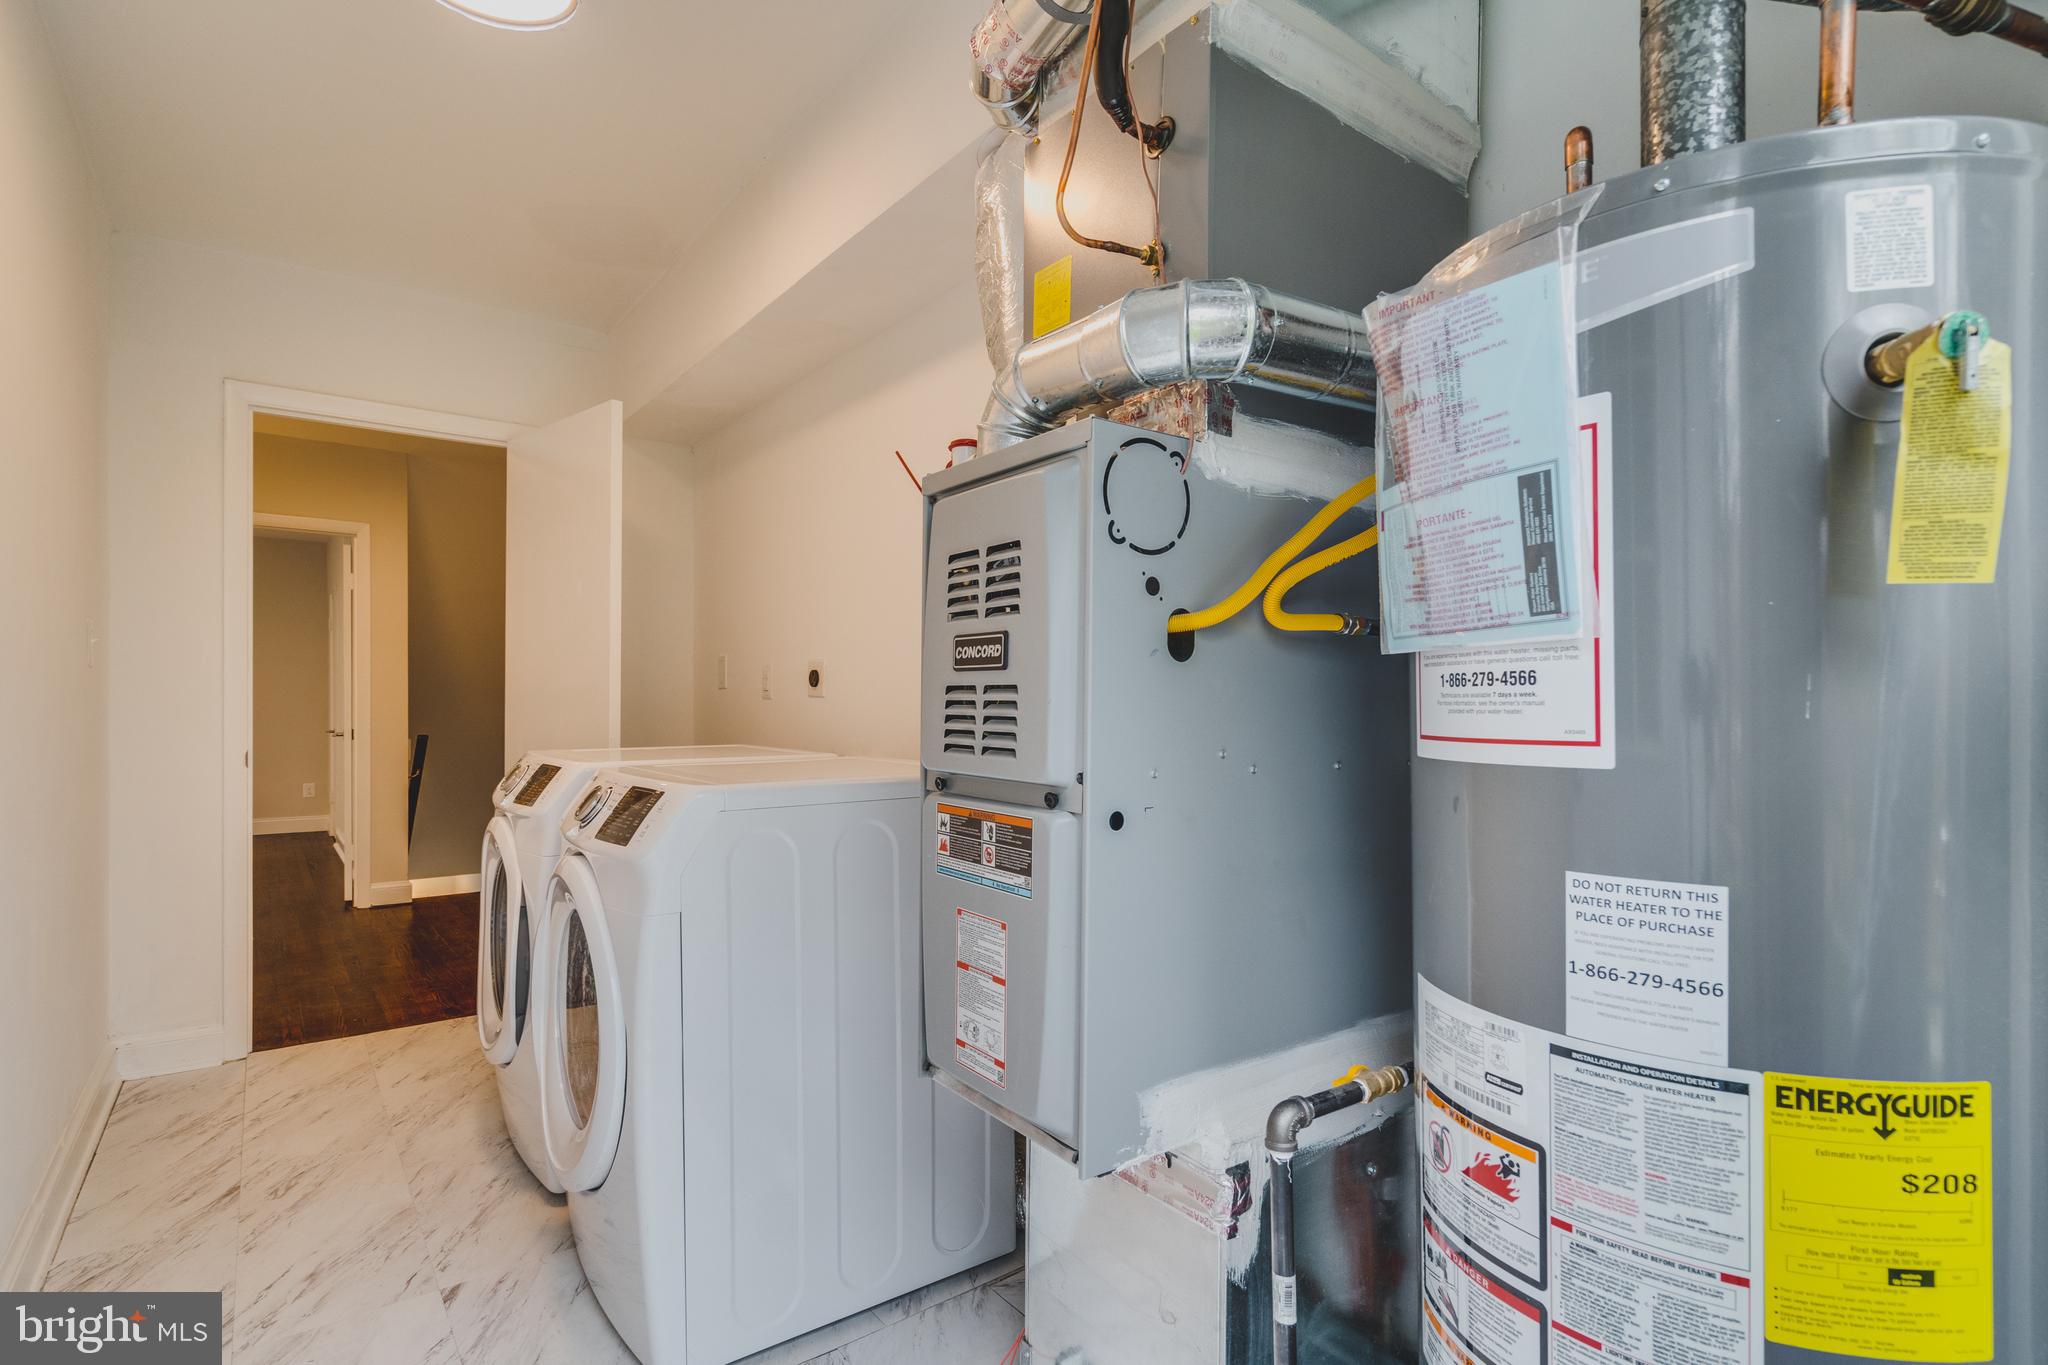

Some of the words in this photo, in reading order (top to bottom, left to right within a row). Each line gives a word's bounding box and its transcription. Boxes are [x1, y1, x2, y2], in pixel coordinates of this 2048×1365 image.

[1378, 290, 1435, 320] IMPORTANT
[956, 644, 1002, 659] CONCORD
[1440, 670, 1537, 688] 1-866-279-4566
[1498, 691, 1512, 699] days
[1572, 878, 1591, 890] DO
[1594, 881, 1622, 894] NOT
[1626, 885, 1682, 900] RETURN
[1688, 891, 1719, 903] THIS
[1569, 894, 1612, 909] WATER
[1615, 900, 1667, 916] HEATER
[1672, 906, 1690, 918] TO
[1694, 909, 1723, 921] THE
[1575, 911, 1613, 925] PLACE
[1617, 917, 1635, 927] OF
[1639, 920, 1715, 938] PURCHASE
[1568, 960, 1725, 998] 1-866-279-4566
[1571, 1051, 1621, 1071] INSTALLATION
[1621, 1063, 1639, 1074] AND
[1639, 1066, 1686, 1083] OPERATION
[1686, 1076, 1720, 1089] DETAILS
[1576, 1067, 1617, 1083] AUTOMATIC
[1619, 1075, 1653, 1091] STORAGE
[1655, 1085, 1682, 1096] WATER
[1684, 1090, 1716, 1103] HEATER
[1776, 1085, 1974, 1118] ENERGYGUIDE
[1816, 1148, 1856, 1160] Estimated
[1859, 1152, 1884, 1163] Yearly
[1887, 1154, 1914, 1164] Energy
[1901, 1173, 1978, 1196] $208
[1576, 1229, 1588, 1239] FOR
[1589, 1233, 1606, 1246] YOUR
[1606, 1240, 1630, 1254] SAFETY
[1631, 1248, 1649, 1261] READ
[1650, 1255, 1676, 1269] BEFORE
[1677, 1262, 1718, 1280] OPERATING
[1451, 1252, 1490, 1290] DANGER
